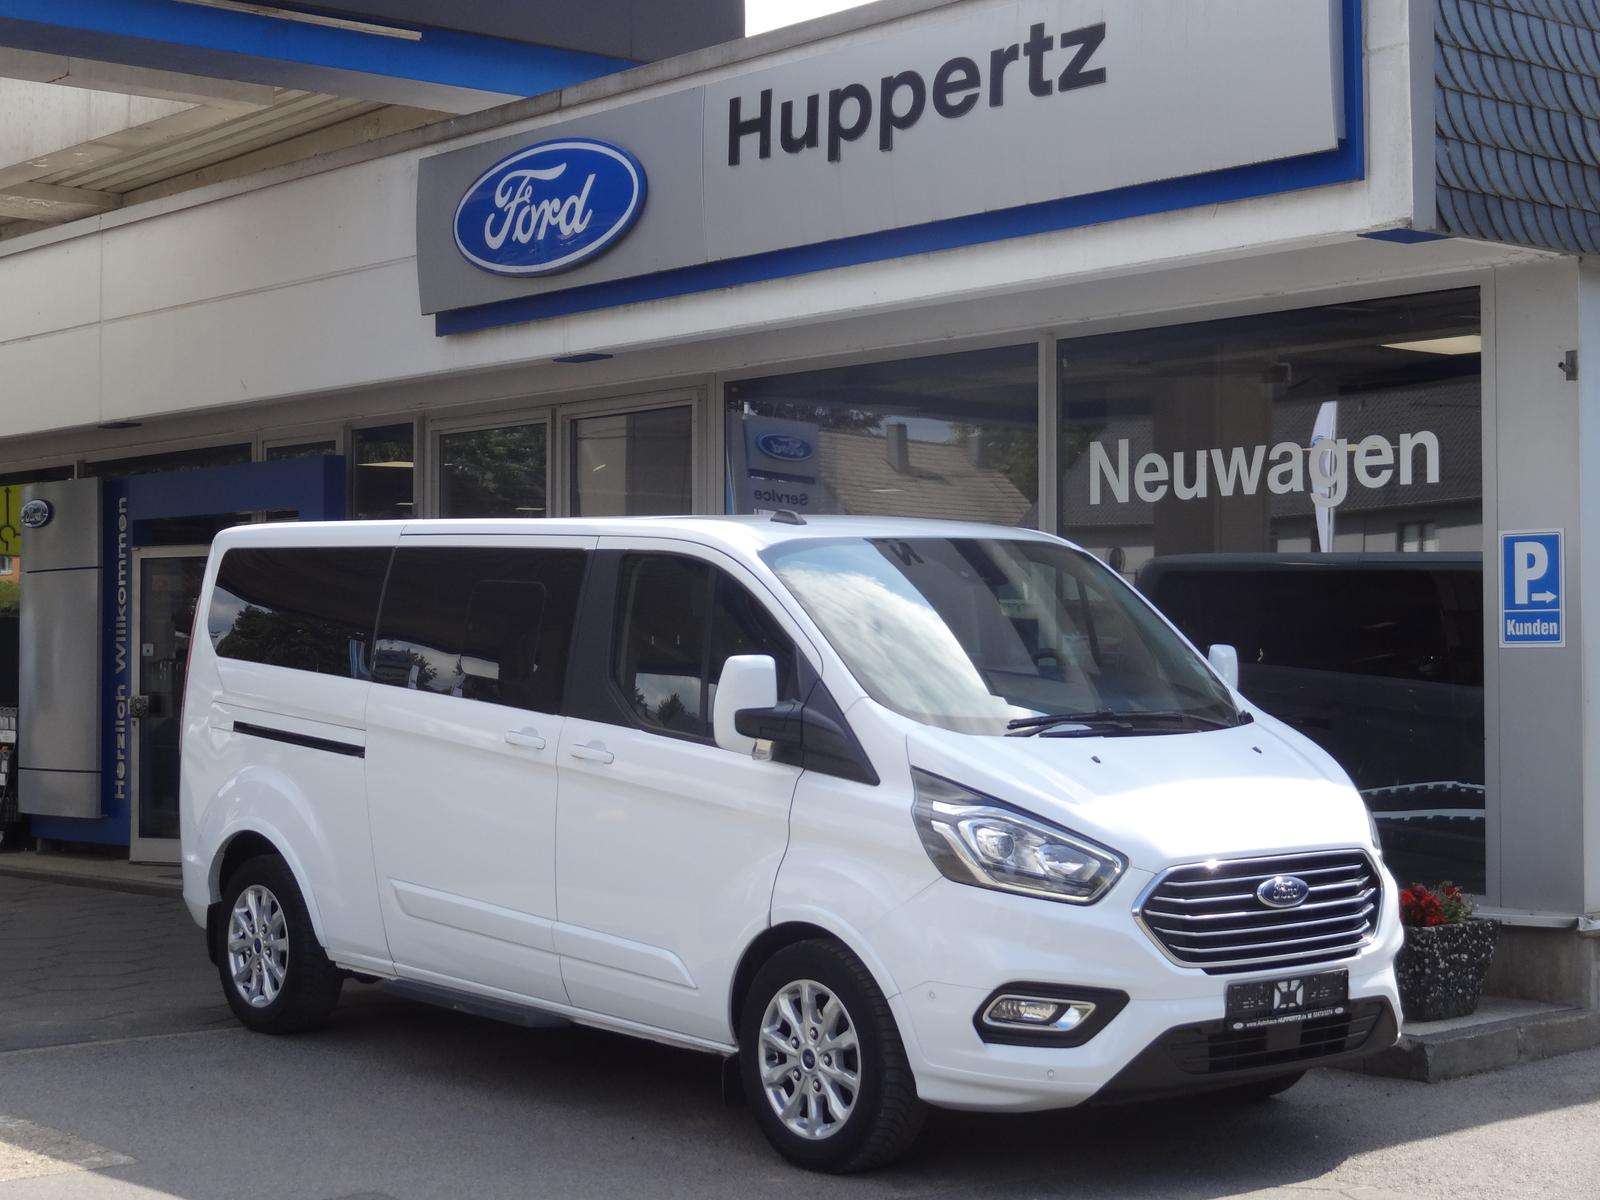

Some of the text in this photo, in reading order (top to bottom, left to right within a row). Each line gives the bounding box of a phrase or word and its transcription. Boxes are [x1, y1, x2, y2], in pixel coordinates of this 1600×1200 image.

[727, 21, 1107, 167] Huppertz
[484, 160, 596, 250] Ford
[1088, 429, 1440, 509] Neuwagen
[1513, 541, 1549, 605] P
[114, 496, 128, 799] Herzlich Willkommen
[1506, 618, 1558, 636] Kunden
[1272, 880, 1301, 900] Ford
